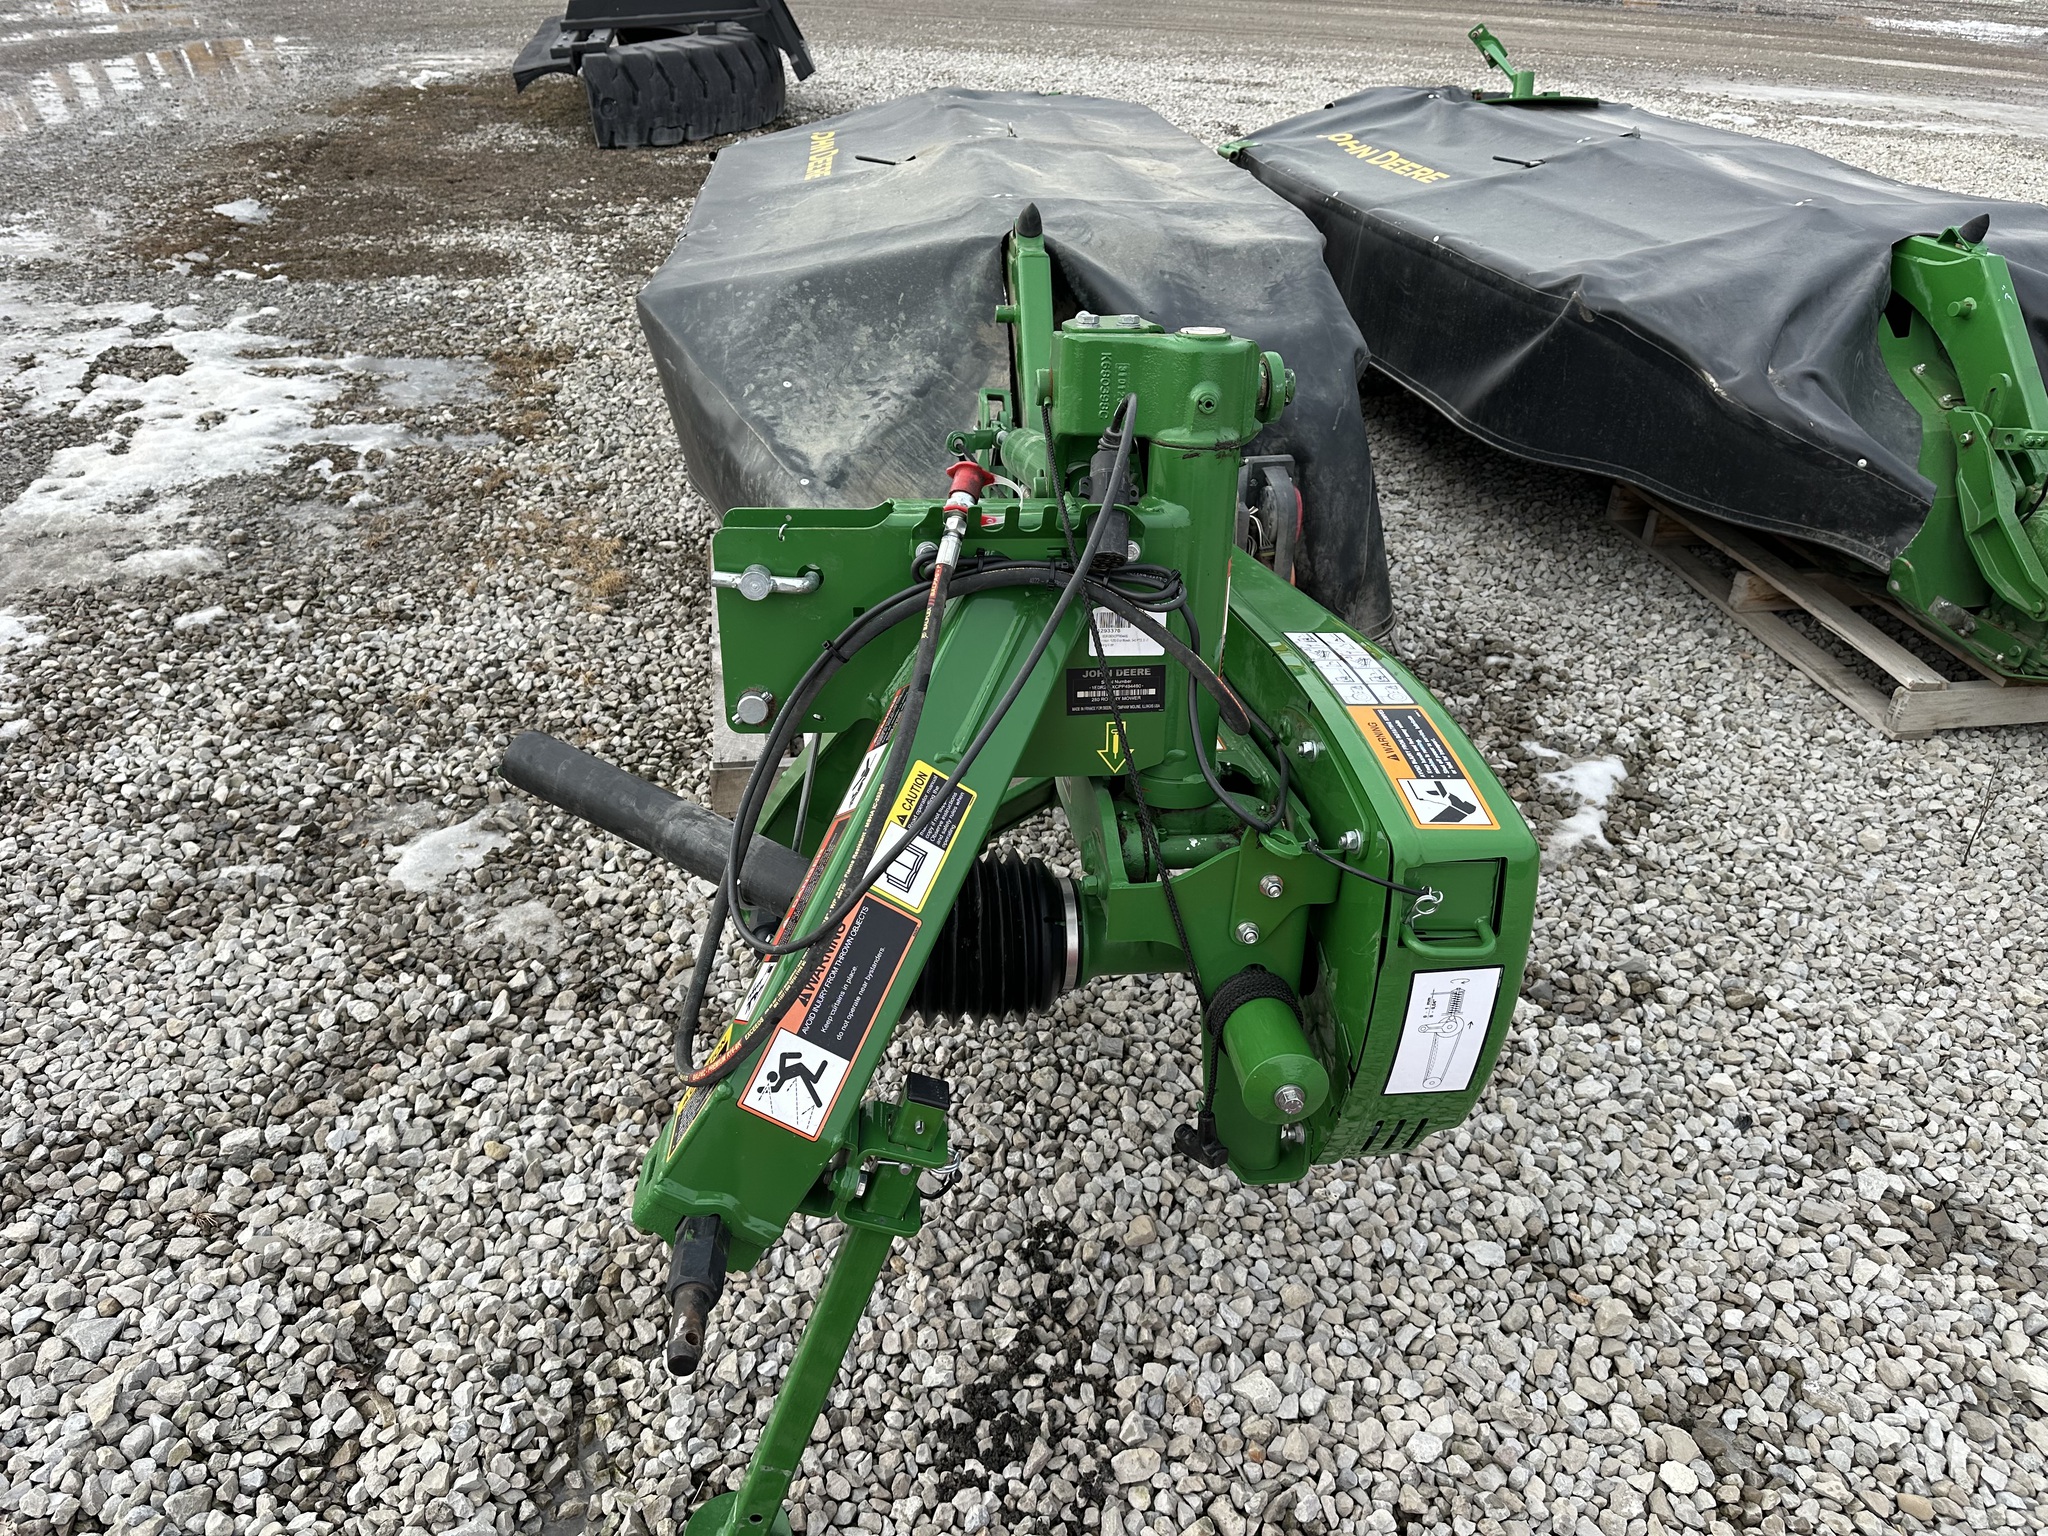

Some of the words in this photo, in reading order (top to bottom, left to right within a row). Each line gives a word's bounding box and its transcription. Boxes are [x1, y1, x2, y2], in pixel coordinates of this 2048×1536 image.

[809, 130, 837, 154] OHN
[1316, 132, 1380, 159] JOHN
[1365, 150, 1451, 184] DEERE
[804, 149, 839, 181] DEERE
[1115, 668, 1152, 677] DEERE
[1368, 722, 1395, 753] WARNING
[902, 771, 928, 811] CAUTION
[907, 814, 918, 829] Read
[915, 794, 928, 816] operator
[927, 774, 938, 794] manual
[925, 826, 935, 839] copy
[930, 820, 944, 842] Observe
[941, 792, 958, 820] instructions
[942, 818, 952, 834] safety
[949, 806, 958, 819] rules
[956, 792, 965, 806] when
[802, 1013, 816, 1035] AVOID
[813, 988, 828, 1014] INJURY
[825, 968, 840, 988] FROM
[834, 937, 854, 967] THROWN
[851, 906, 869, 937] OBJECTS
[821, 1015, 834, 1033] Keep
[830, 990, 846, 1017] curtains
[846, 965, 859, 984] place.
[836, 1031, 844, 1041] do
[841, 1019, 850, 1032] not
[846, 996, 861, 1020] operate
[858, 981, 869, 996] near
[864, 946, 886, 981] bystanders.
[744, 1016, 764, 1040] EXCEEDS
